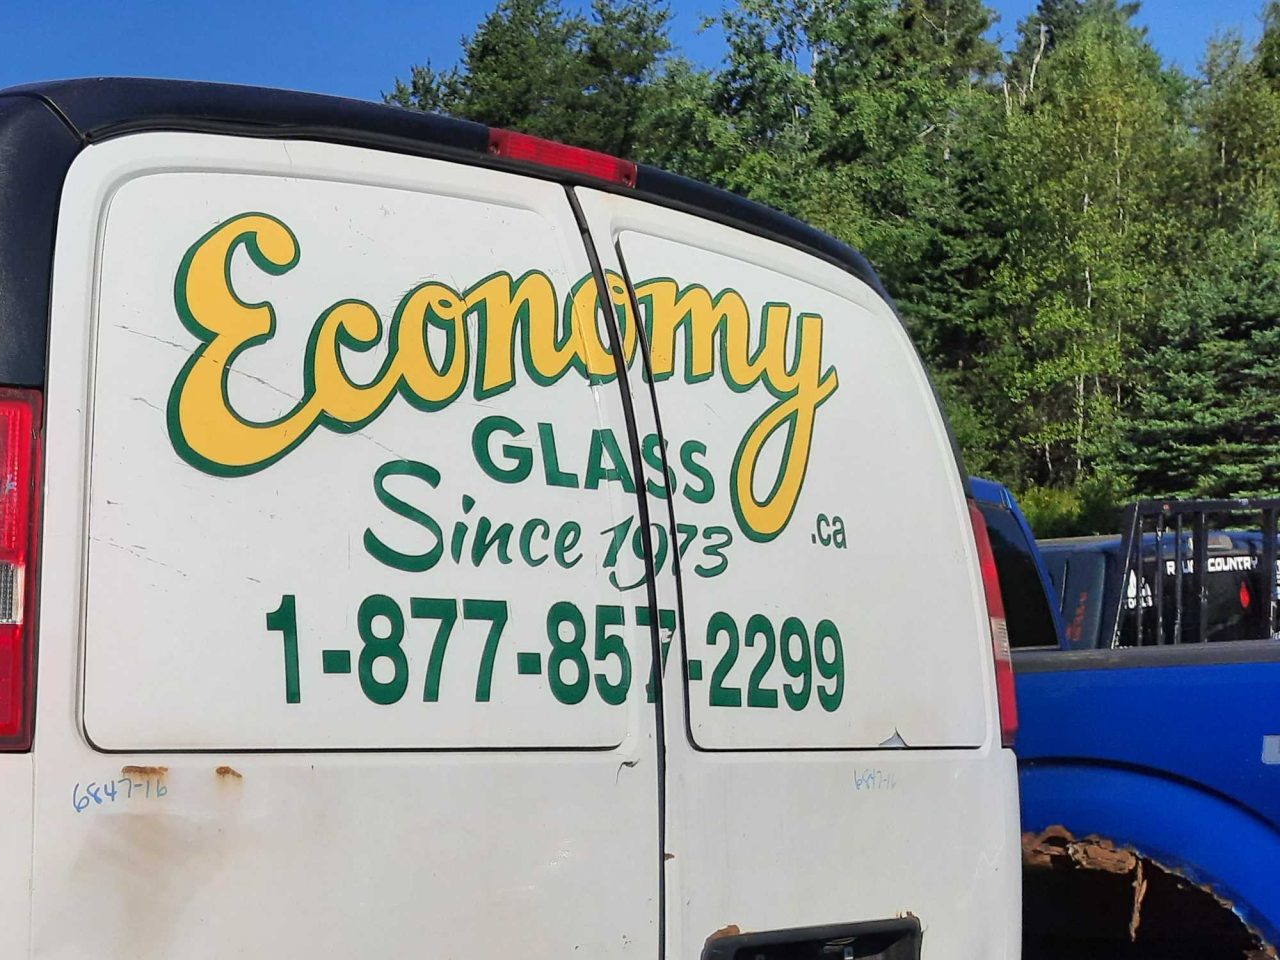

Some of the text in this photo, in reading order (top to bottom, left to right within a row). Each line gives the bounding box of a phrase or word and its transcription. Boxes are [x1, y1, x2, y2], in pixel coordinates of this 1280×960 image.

[167, 212, 839, 543] Economy
[472, 416, 715, 504] GLASS
[363, 460, 733, 591] Since 1973
[1207, 556, 1258, 573] COUNTRY
[266, 594, 845, 712] 1-877-857-2299
[72, 777, 168, 813] 6847-16
